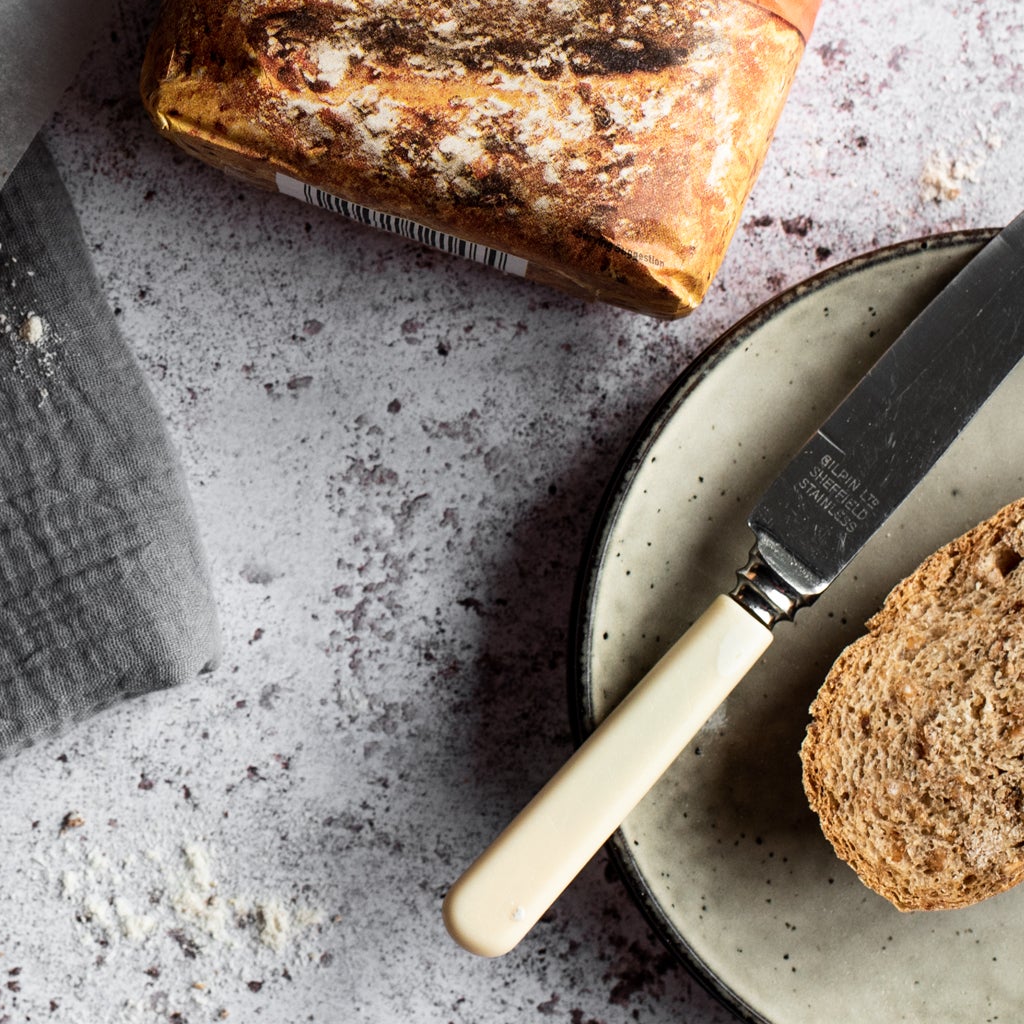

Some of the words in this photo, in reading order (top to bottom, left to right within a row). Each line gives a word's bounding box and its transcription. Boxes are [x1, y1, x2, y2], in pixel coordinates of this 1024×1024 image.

[809, 465, 868, 520] SHEFFIELD
[820, 454, 861, 491] GILPIN
[798, 477, 857, 533] STAINLESS
